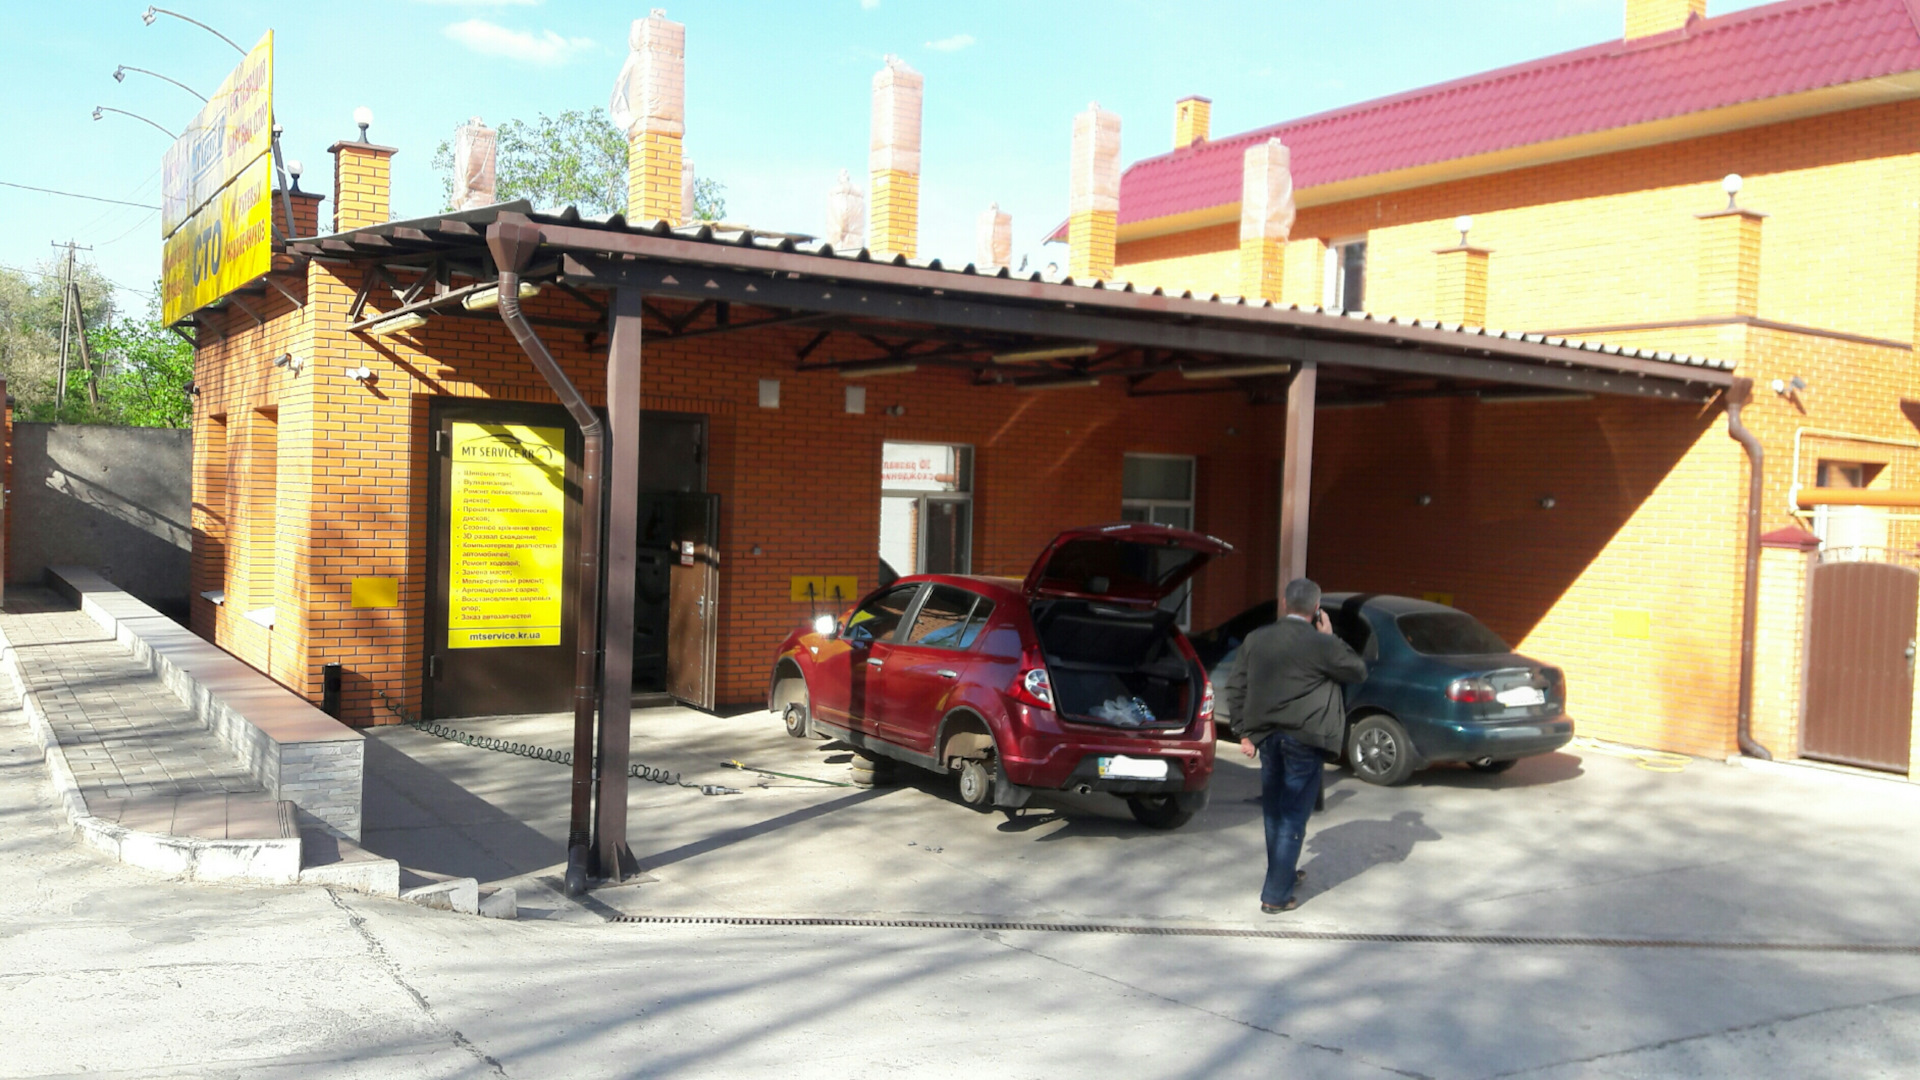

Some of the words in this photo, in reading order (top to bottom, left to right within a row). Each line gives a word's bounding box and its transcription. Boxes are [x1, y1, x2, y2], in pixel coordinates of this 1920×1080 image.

[193, 220, 222, 287] СТО
[462, 447, 478, 456] MT
[480, 447, 518, 458] SERVICE
[469, 632, 540, 640] mtservice.kr.ua
